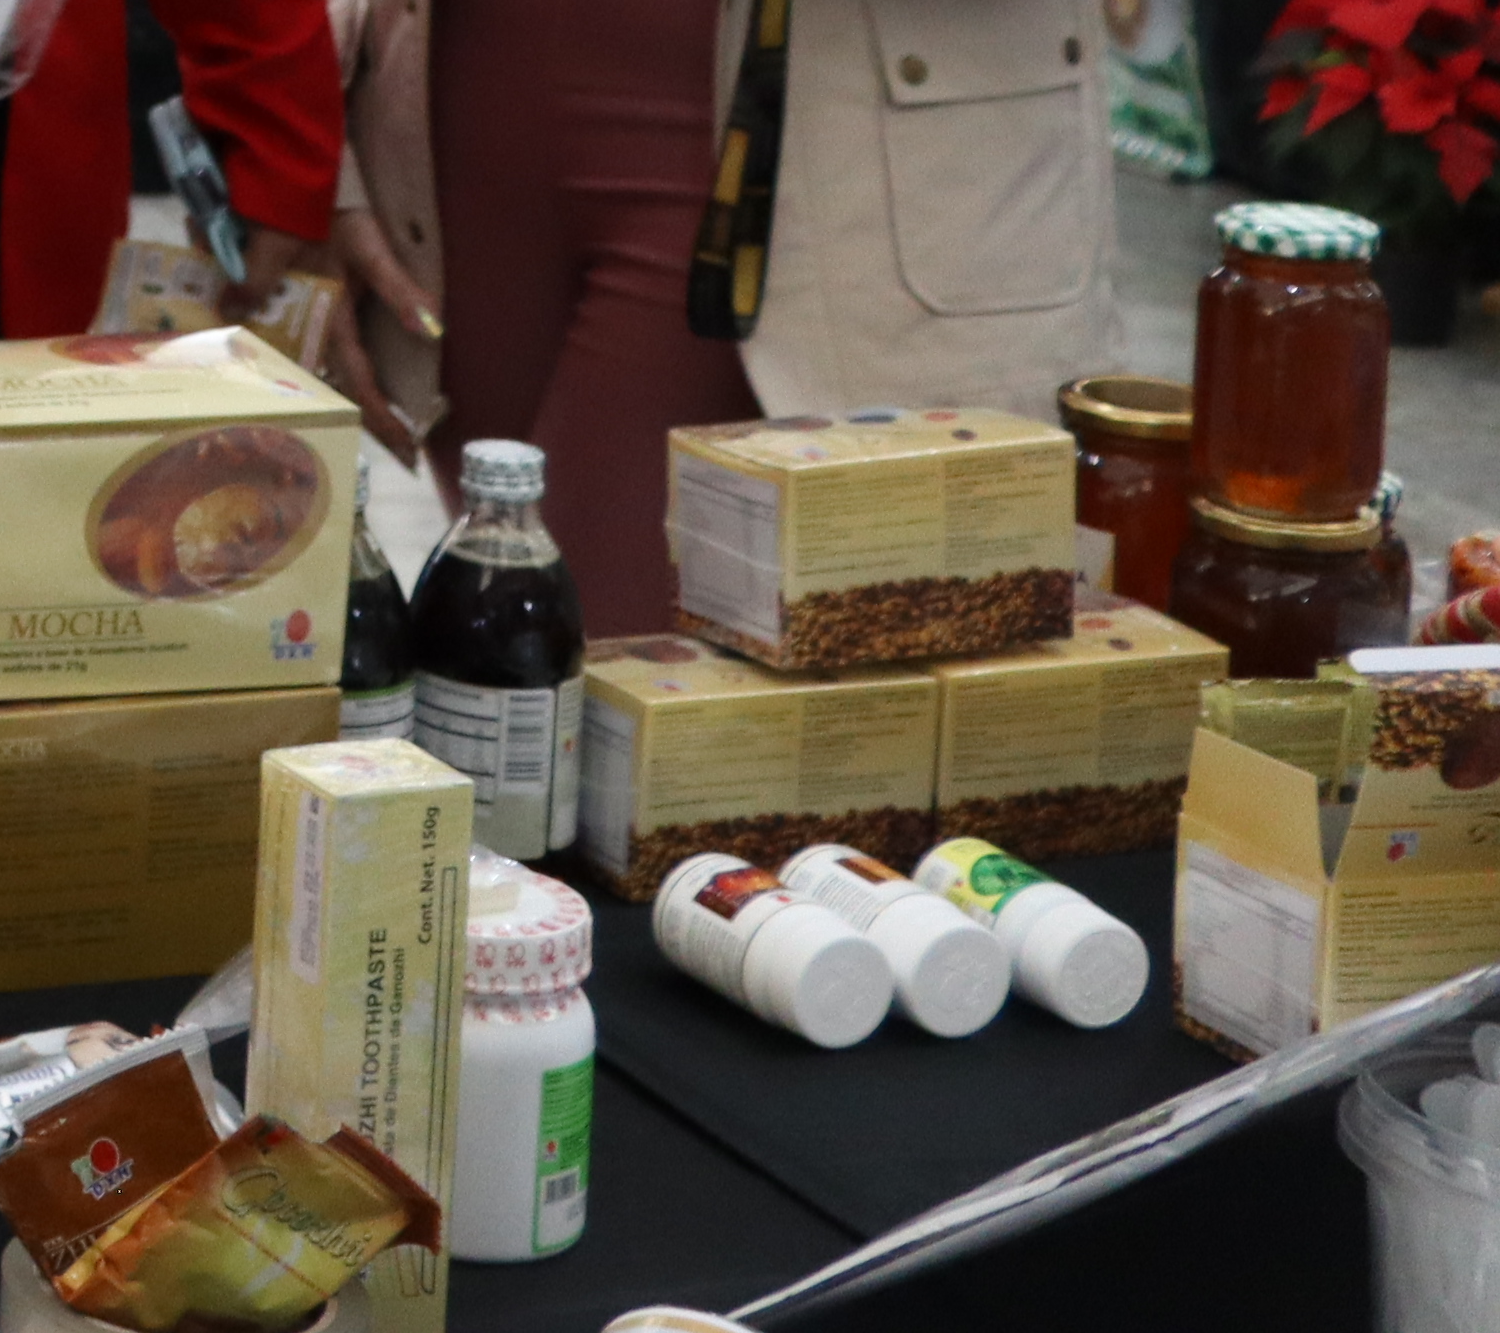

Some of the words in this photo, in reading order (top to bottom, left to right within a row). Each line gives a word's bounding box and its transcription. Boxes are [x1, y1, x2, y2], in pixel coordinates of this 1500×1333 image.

[10, 609, 145, 640] MOCHA
[422, 806, 441, 850] 150g
[420, 855, 436, 893] Net.
[418, 896, 433, 945] Cont.
[389, 947, 405, 1015] Ganozhi
[361, 928, 388, 1091] TOOTHPASTE
[83, 1159, 134, 1200] DXN
